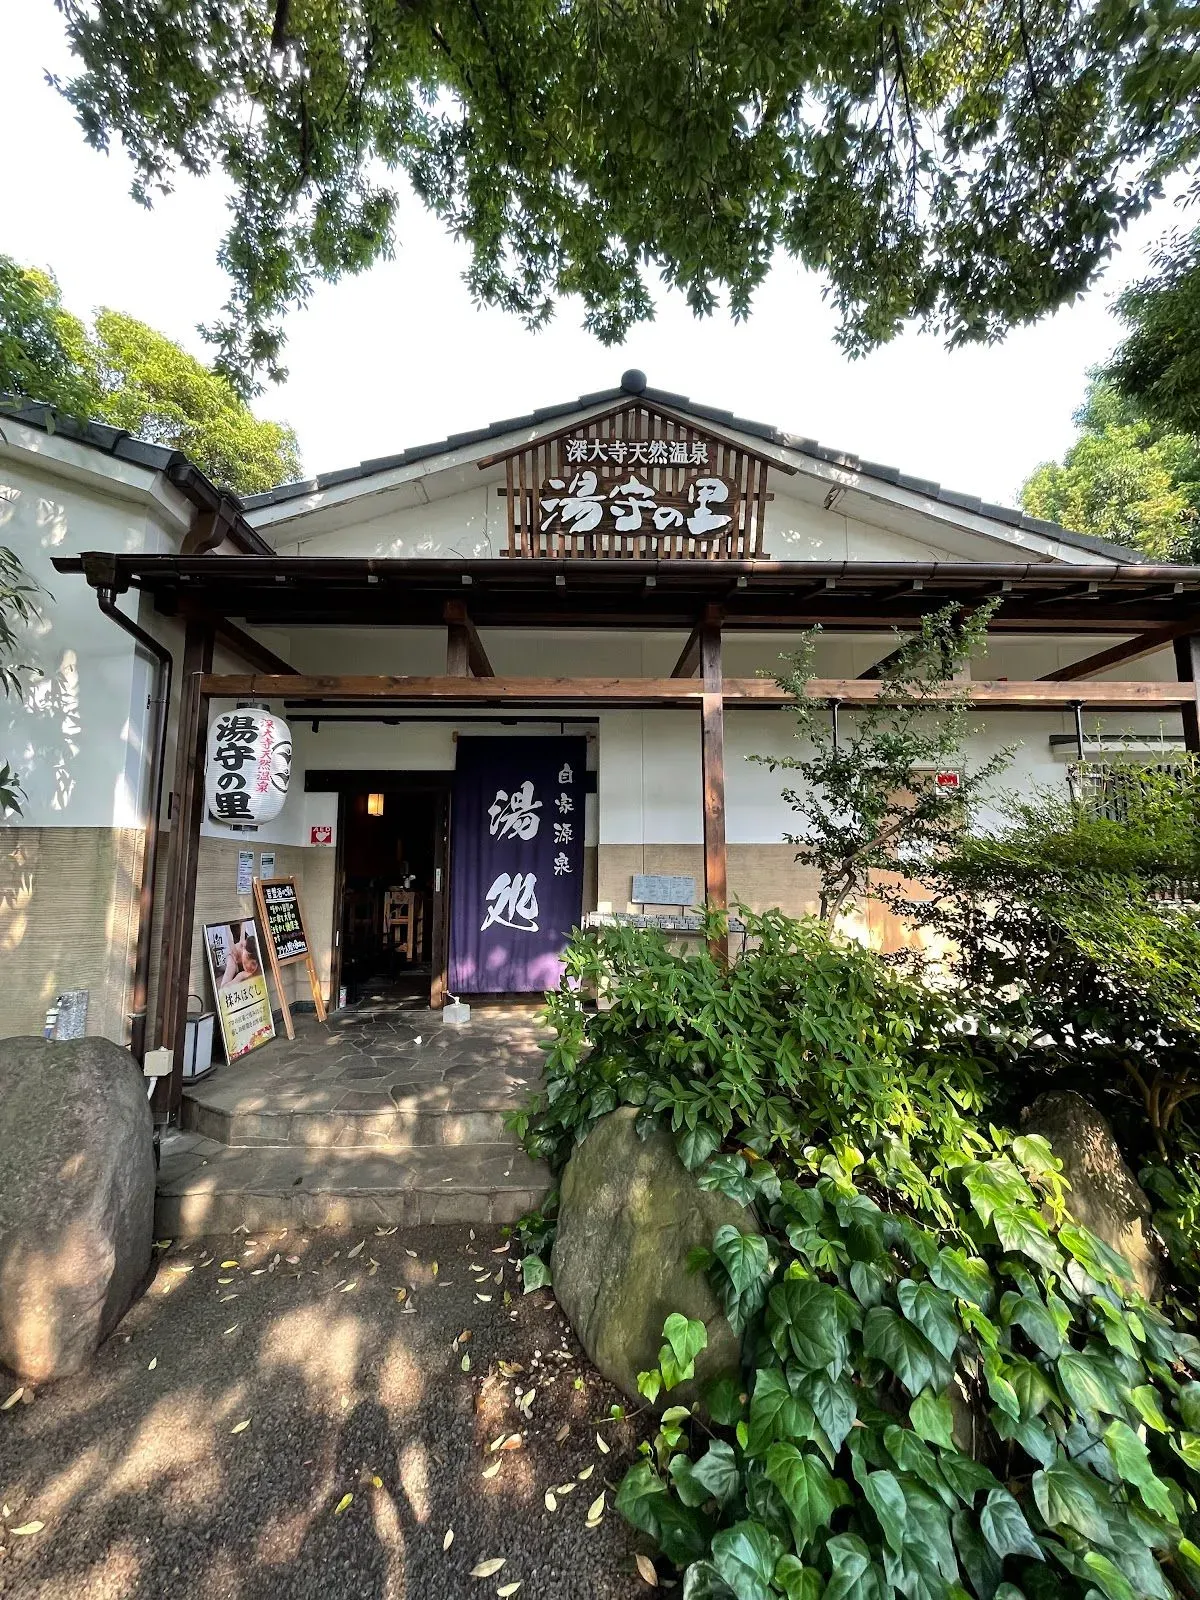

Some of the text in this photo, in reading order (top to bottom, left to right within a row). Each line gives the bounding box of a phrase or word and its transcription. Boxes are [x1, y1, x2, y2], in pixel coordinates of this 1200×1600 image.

[566, 439, 709, 465] 深大寺天然温泉
[540, 470, 732, 535] 湯守の里
[213, 715, 260, 820] 湯守の里
[256, 718, 276, 793] 深大寺天然温泉
[480, 780, 543, 933] 湯処
[553, 762, 575, 876] 自家源泉
